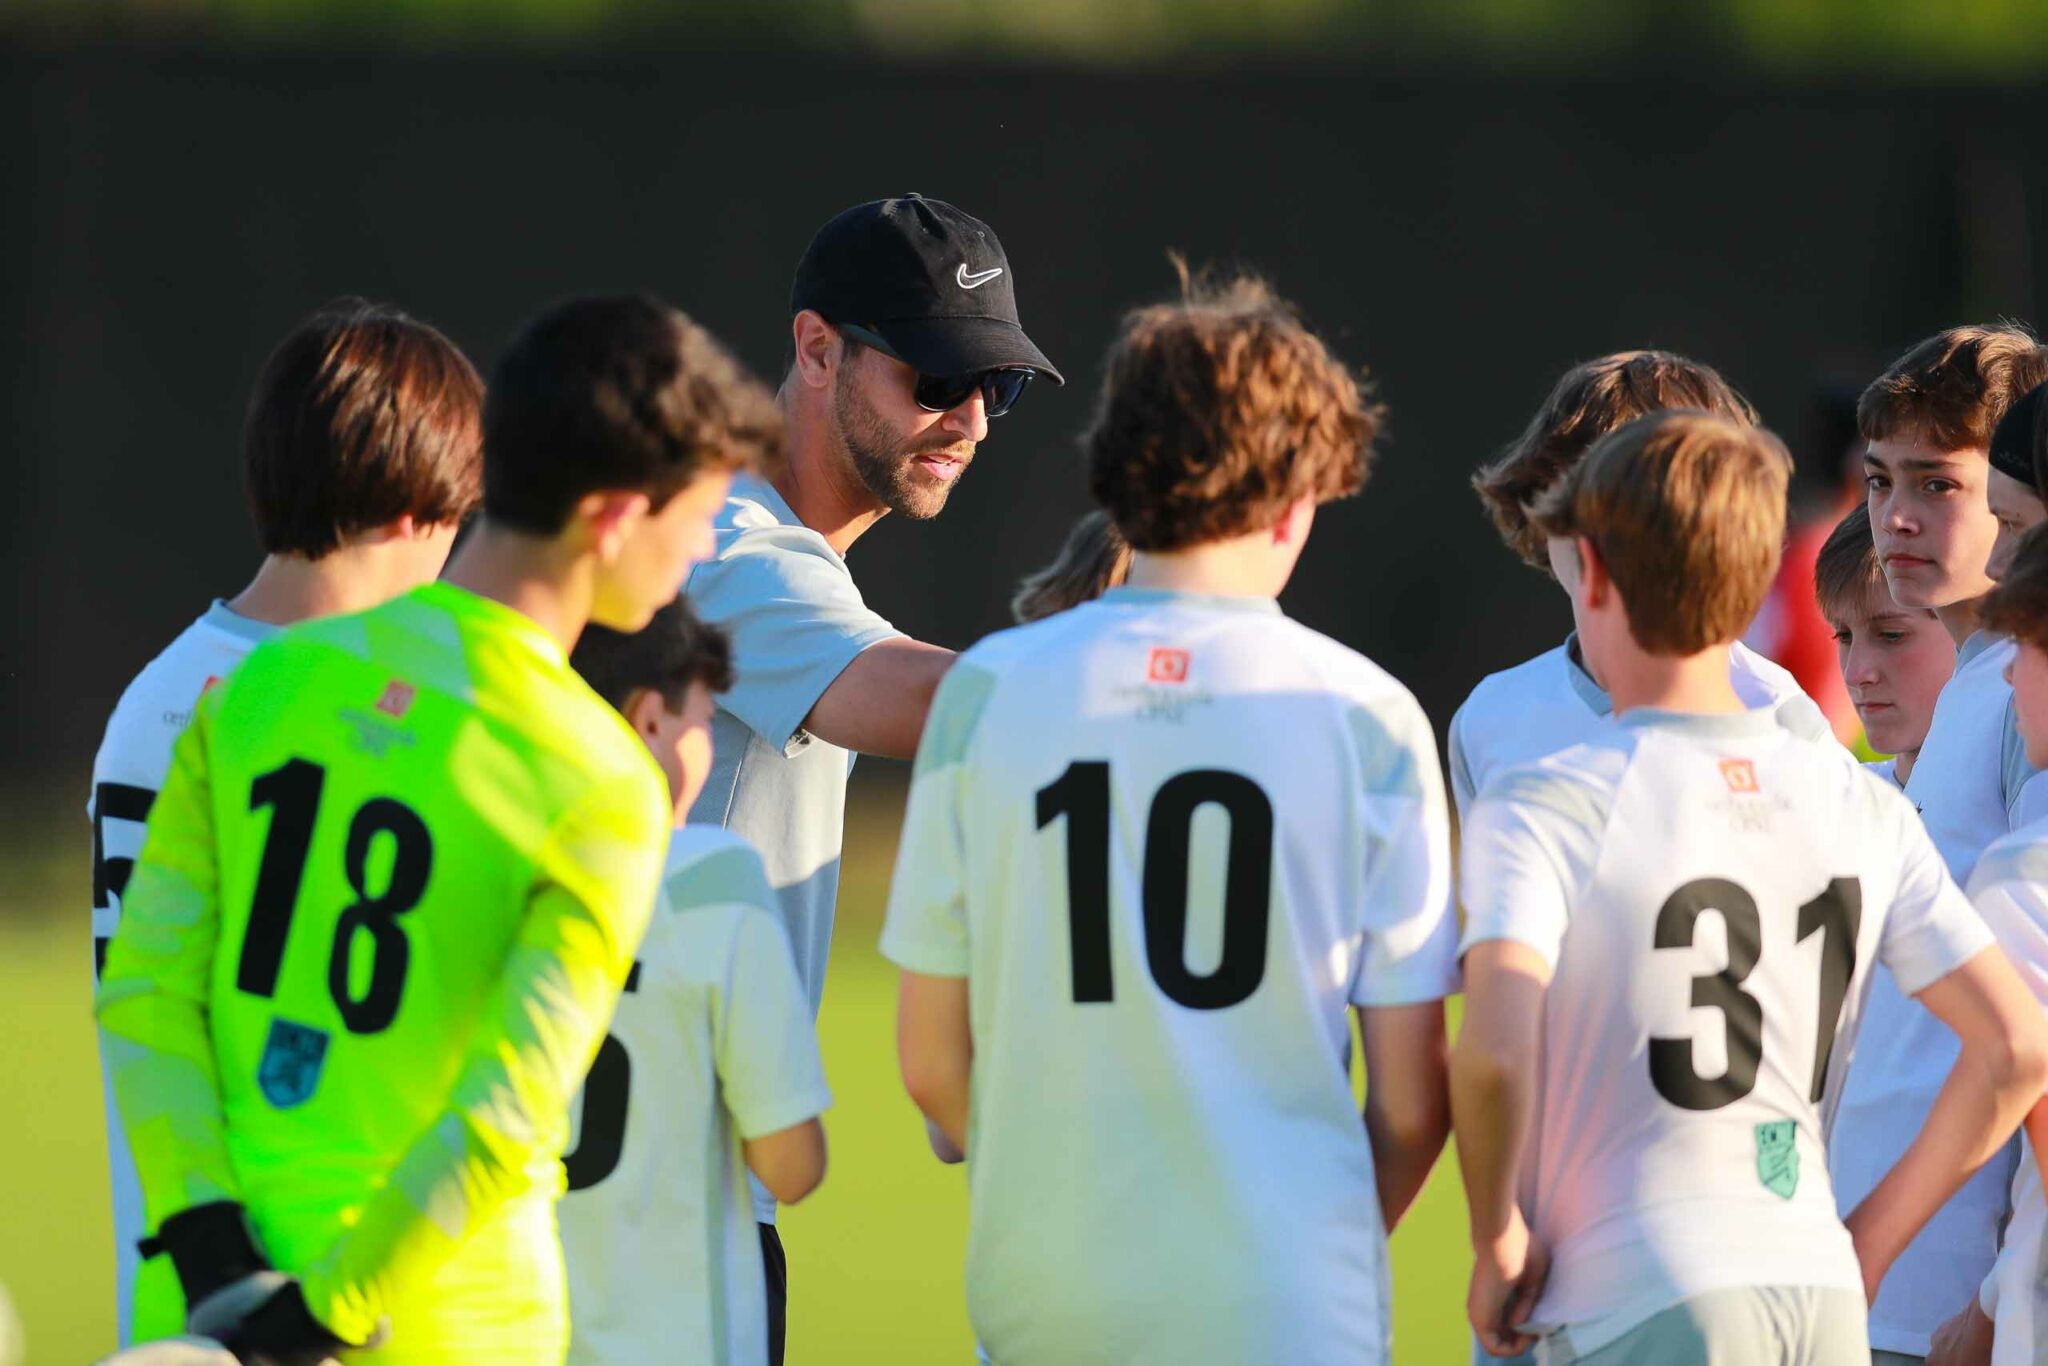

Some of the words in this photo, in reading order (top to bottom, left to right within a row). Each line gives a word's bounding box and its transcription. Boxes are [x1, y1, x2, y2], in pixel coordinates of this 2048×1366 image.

[236, 756, 434, 1034] 18
[1035, 761, 1273, 1011] 10
[1648, 877, 1861, 1111] 31
